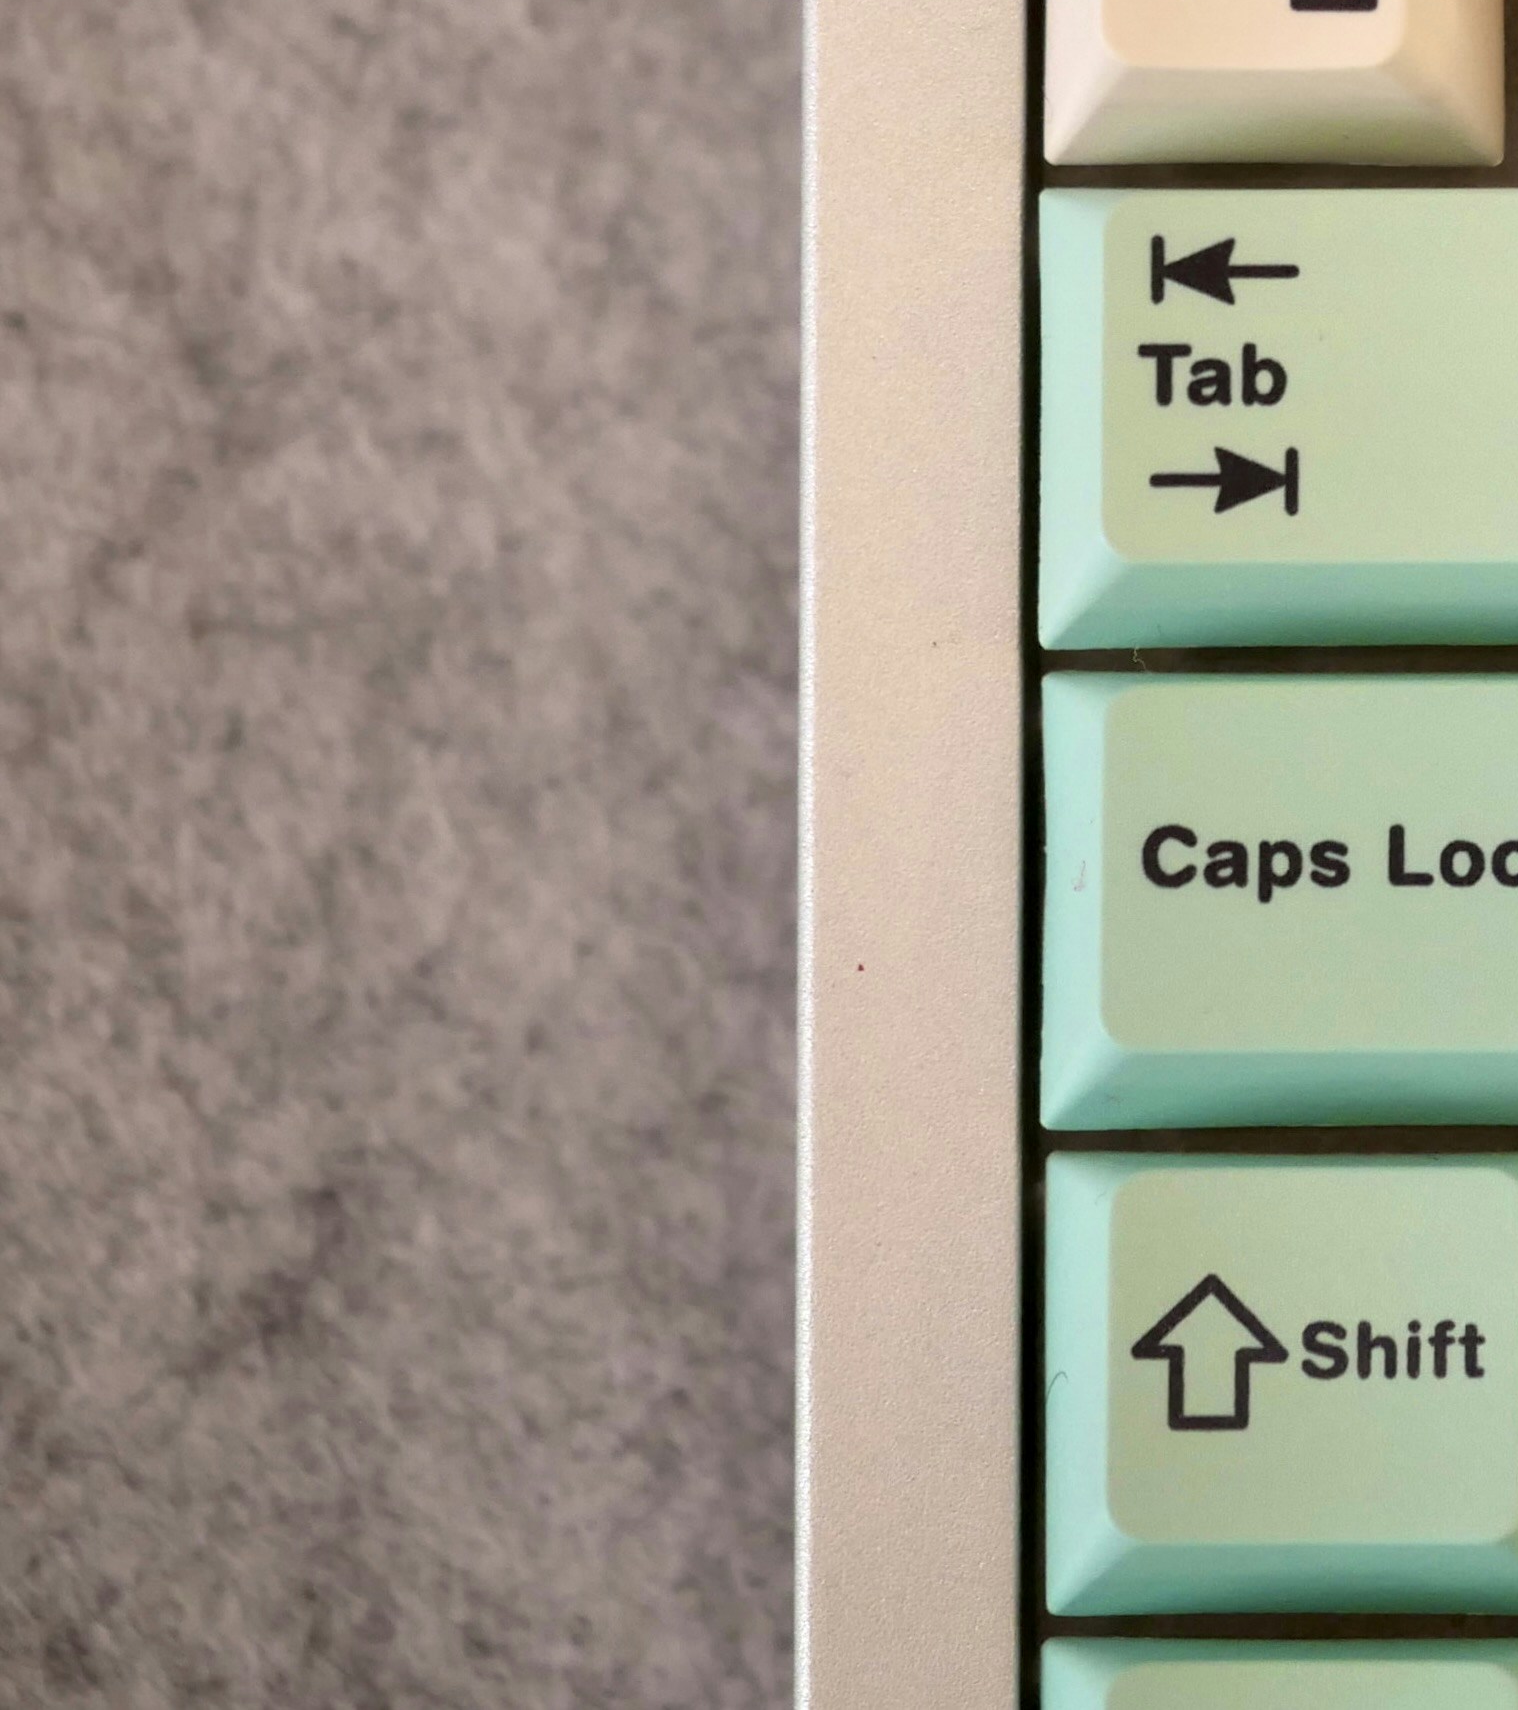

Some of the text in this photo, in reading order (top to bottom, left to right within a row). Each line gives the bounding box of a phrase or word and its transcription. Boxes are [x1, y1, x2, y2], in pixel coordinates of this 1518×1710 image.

[1136, 341, 1289, 408] Tab
[1140, 823, 1352, 905] Caps
[1300, 1318, 1487, 1381] Shift
